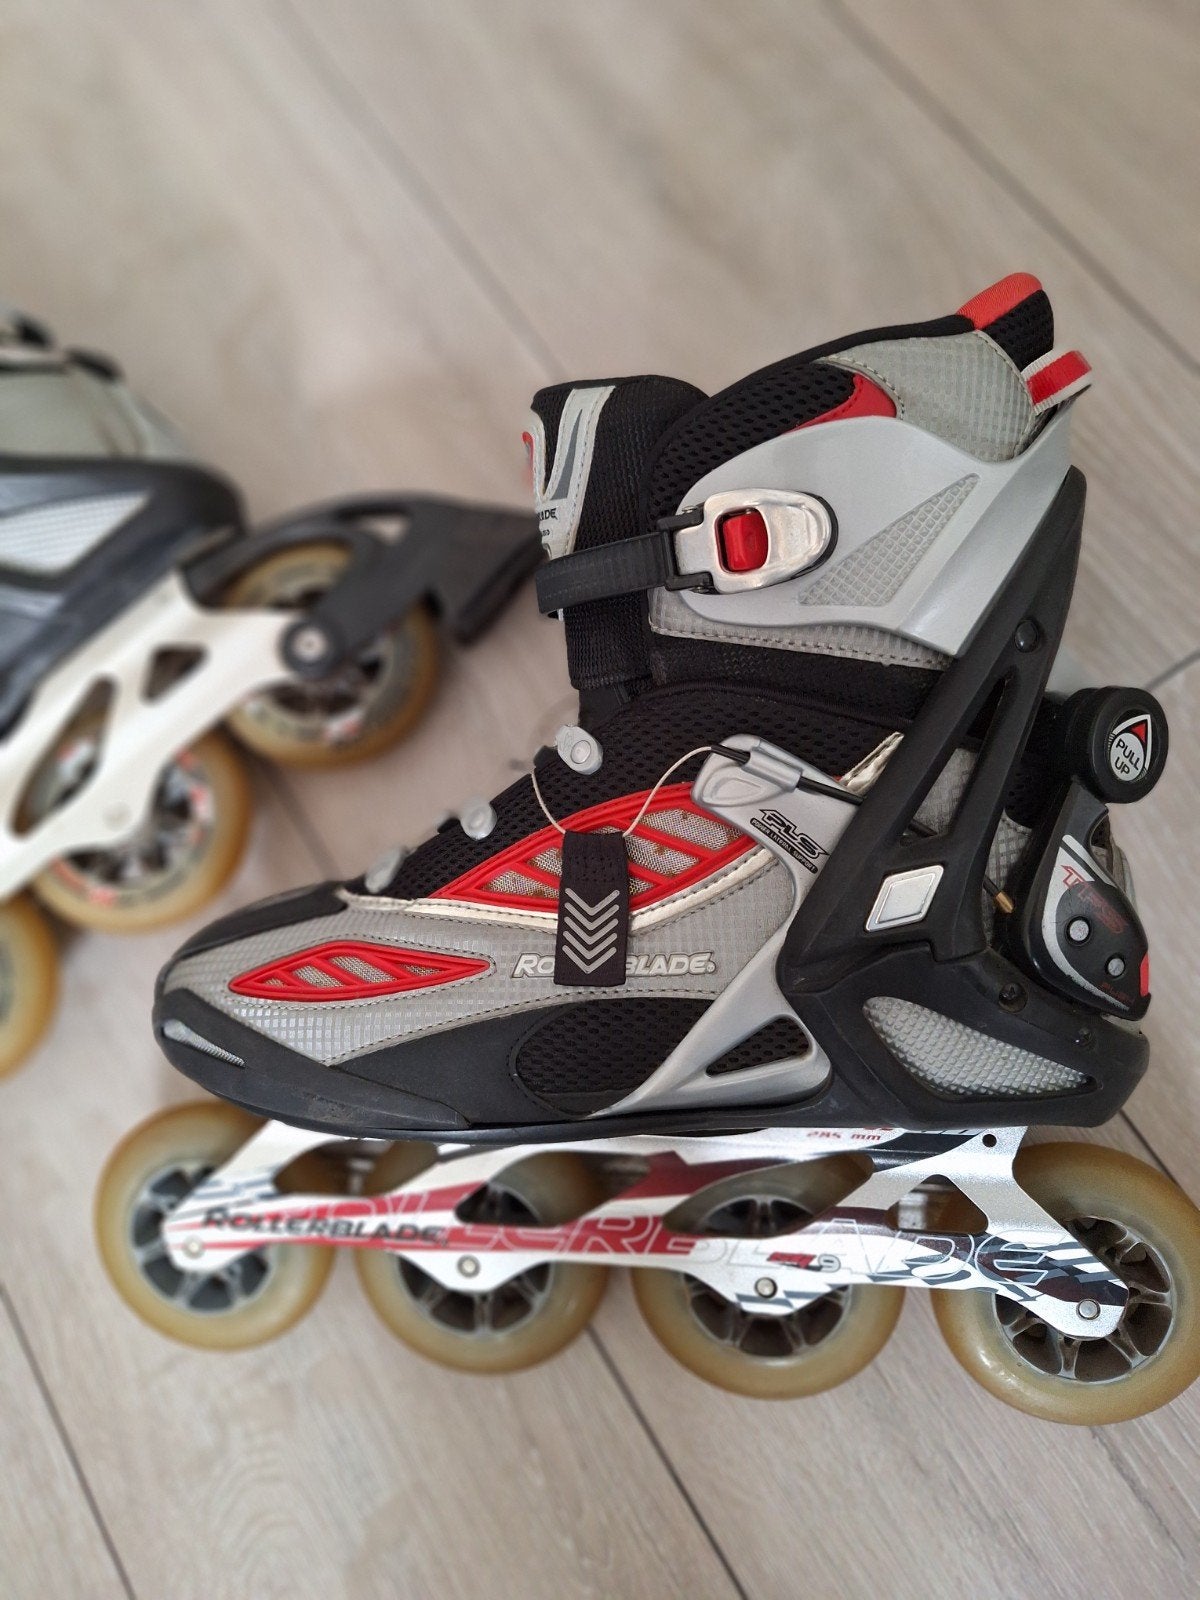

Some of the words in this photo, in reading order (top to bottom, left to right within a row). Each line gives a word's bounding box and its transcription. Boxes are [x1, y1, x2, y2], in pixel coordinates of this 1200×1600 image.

[1115, 756, 1131, 775] UP
[1116, 738, 1140, 771] PULL
[762, 811, 822, 857] PLS
[851, 1132, 882, 1142] mm
[203, 1205, 448, 1245] ROLLERBLADE
